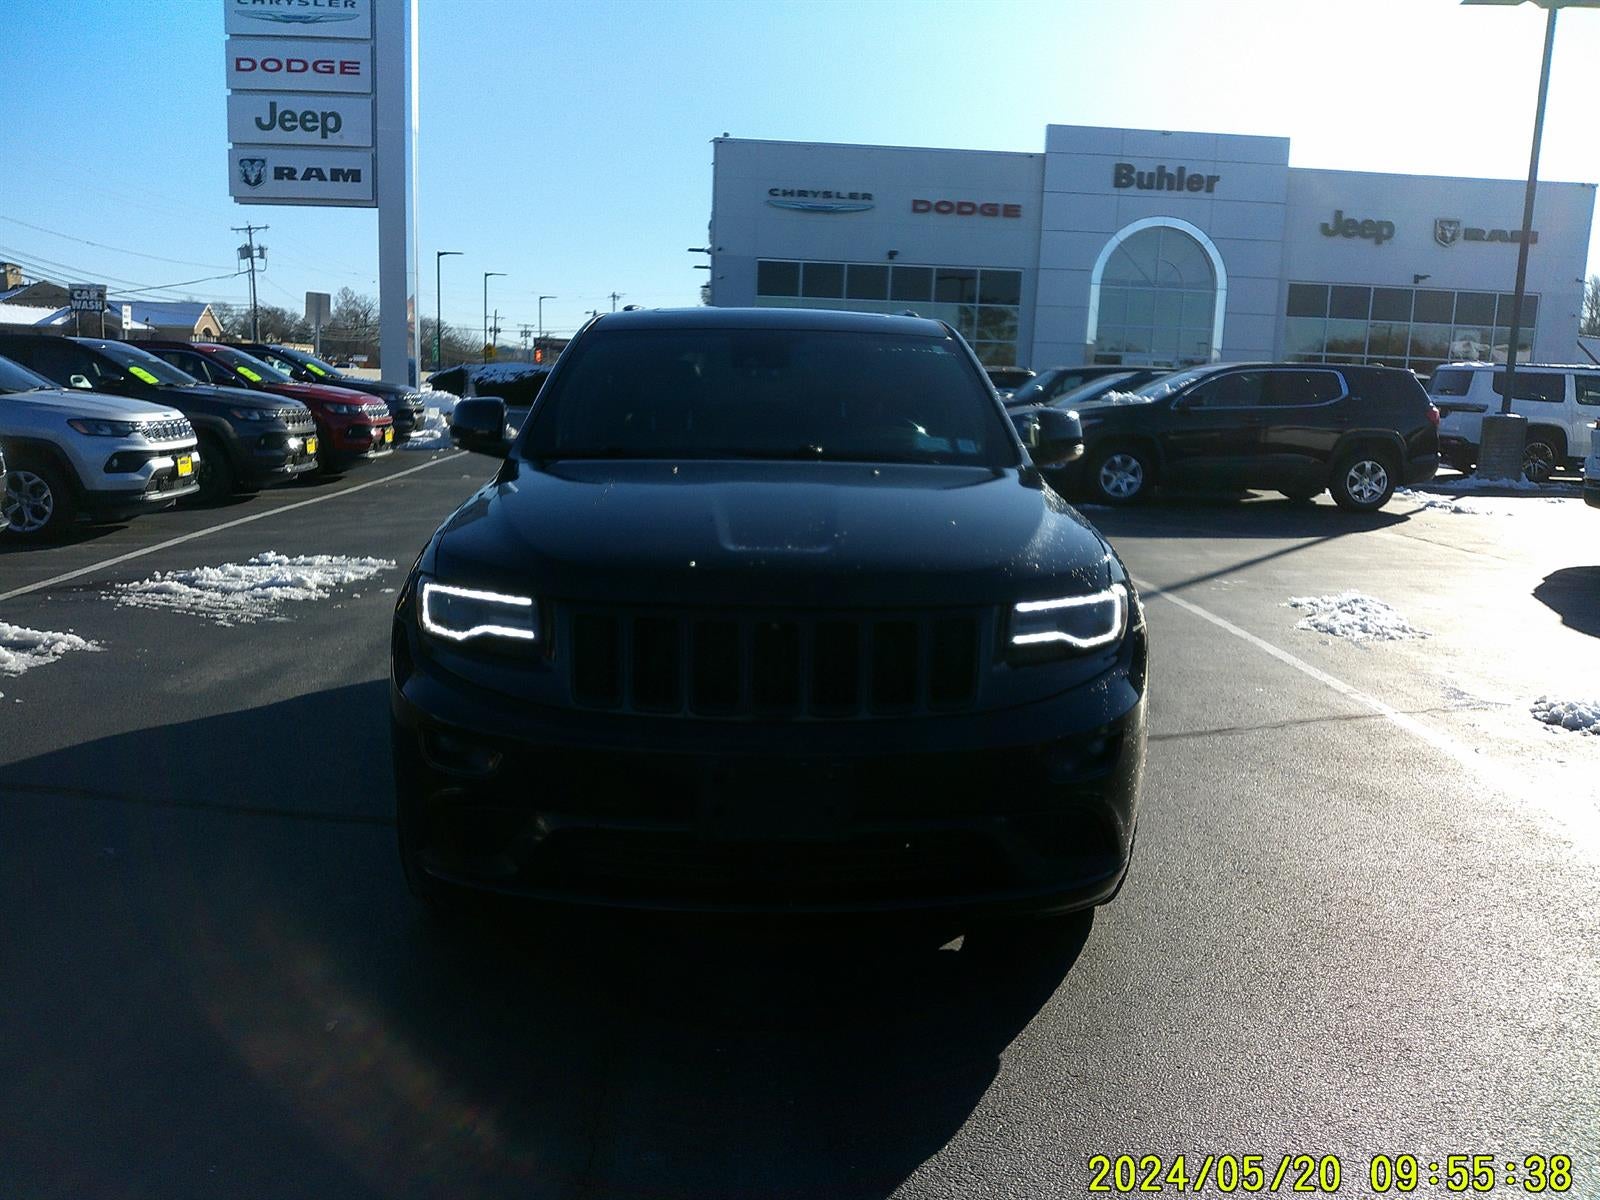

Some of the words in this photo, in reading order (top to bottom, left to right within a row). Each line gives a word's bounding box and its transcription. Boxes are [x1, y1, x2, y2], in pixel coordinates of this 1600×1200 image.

[235, 57, 361, 76] DODGE
[255, 101, 342, 139] Jeep
[273, 166, 362, 183] RAM
[1114, 163, 1220, 193] Buhler
[768, 188, 873, 201] CHRYSLER
[911, 199, 1022, 218] DODGE
[1321, 210, 1396, 245] Jeep
[73, 290, 98, 300] CAR
[71, 300, 102, 310] WASH
